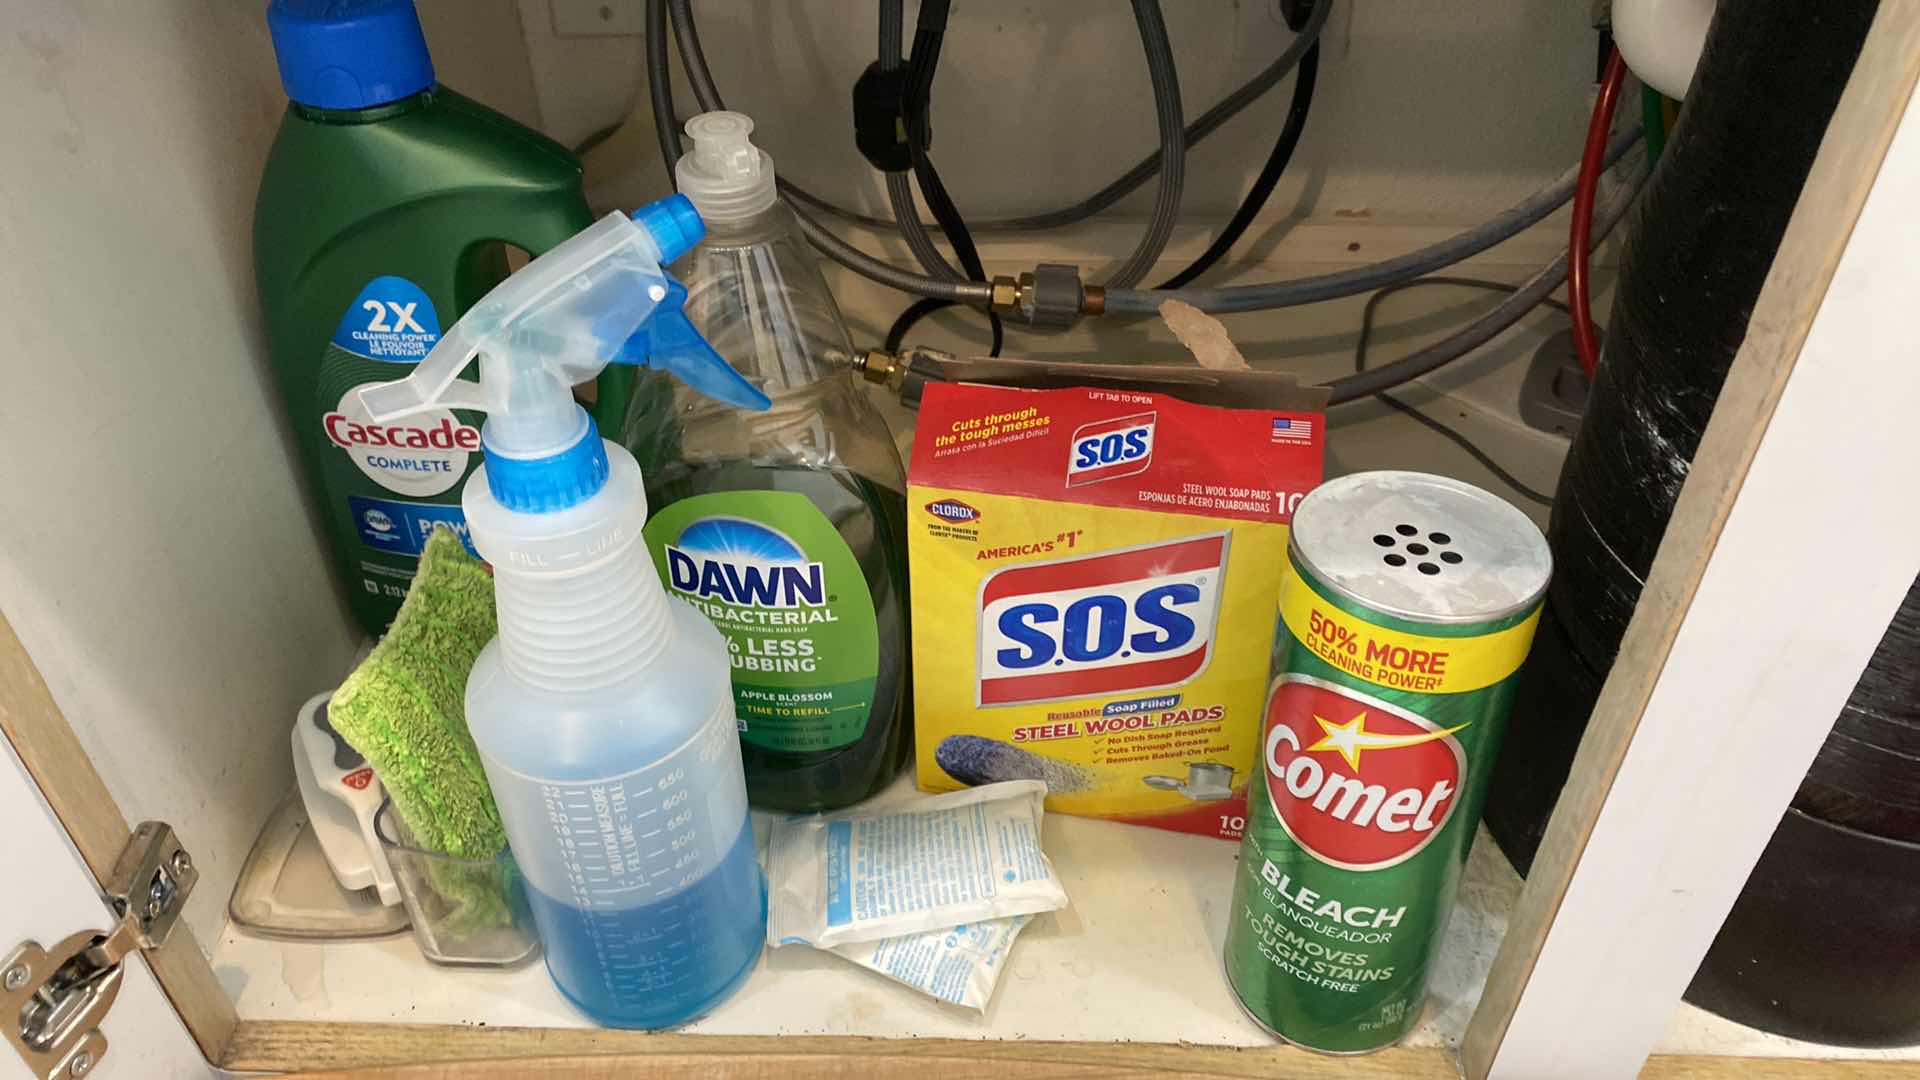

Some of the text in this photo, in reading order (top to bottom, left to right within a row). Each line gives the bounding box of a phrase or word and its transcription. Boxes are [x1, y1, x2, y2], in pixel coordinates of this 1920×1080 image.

[363, 300, 426, 333] 2X
[352, 331, 436, 342] CLEANING POWER
[1088, 391, 1153, 405] LIFT TAB TO OPEN
[952, 406, 1037, 432] Cuts through
[325, 414, 480, 450] Cascade
[935, 415, 1051, 448] the tough messes
[934, 446, 960, 459] Arrasa
[962, 443, 977, 453] con
[978, 441, 986, 449] la
[987, 434, 1025, 448] Suciedad
[367, 455, 452, 472] COMPLETE
[1138, 490, 1271, 513] ESPONJAS DE ACERO ENJABONADAS
[1182, 483, 1272, 501] STEEL WOOL SOAP PADS
[931, 503, 975, 519] CLOROX
[509, 551, 549, 569] FILL
[976, 541, 1055, 560] AMERICA'S
[668, 547, 823, 606] DAWN
[747, 638, 815, 657] LESS
[1309, 608, 1450, 676] 50% MORE
[1305, 632, 1373, 679] CLEANING
[740, 690, 833, 702] APPLE BLOSSOM
[747, 705, 832, 718] TIME TO REFILL
[1047, 696, 1176, 722] Reusable Soap Filled
[1013, 705, 1225, 742] STEEL WOOL PADS
[1107, 725, 1222, 745] No Dish Soap Required
[1106, 737, 1209, 755] Cuts Through Grease
[1106, 743, 1231, 765] Removes Baked-On Food
[1265, 722, 1457, 834] Comet
[1219, 815, 1245, 831] 10
[1219, 829, 1243, 838] PADS
[1261, 858, 1408, 929] BLEACH
[1263, 887, 1393, 945] BLANQUEADOR
[1243, 903, 1395, 982] TOUGH STAINS
[1262, 912, 1369, 967] REMOVES
[1256, 942, 1361, 994] SCRATCH FREE
